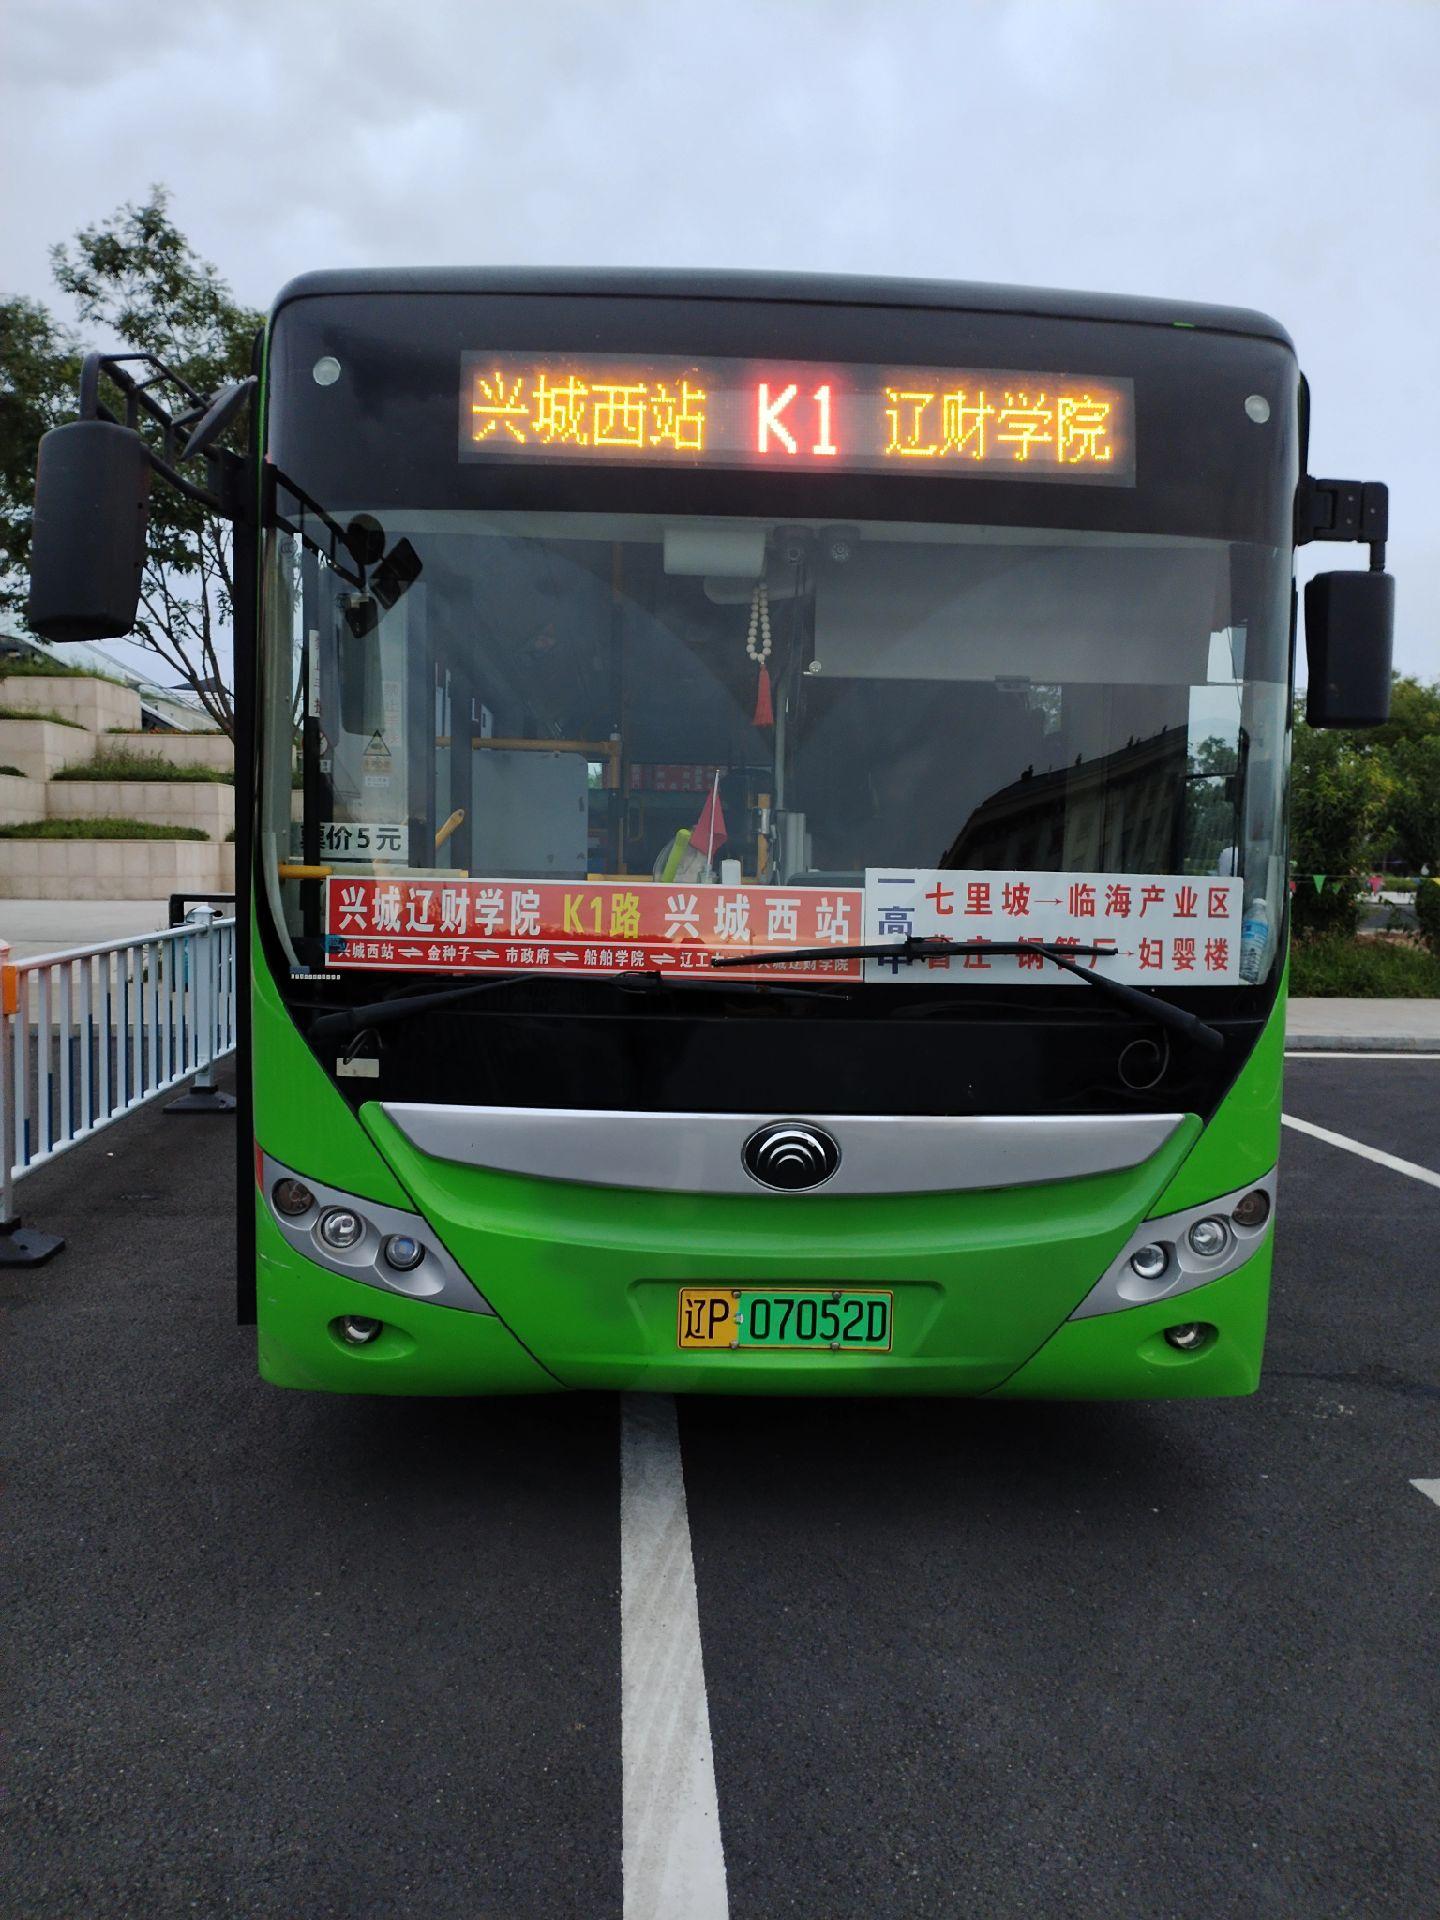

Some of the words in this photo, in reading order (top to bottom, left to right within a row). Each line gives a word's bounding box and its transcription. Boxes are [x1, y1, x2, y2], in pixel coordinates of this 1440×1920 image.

[473, 371, 708, 450] 兴城西站
[758, 384, 837, 455] K1
[885, 387, 1112, 462] 辽财学院
[338, 886, 541, 937] 兴城辽财学院
[563, 892, 641, 940] K1路
[665, 893, 852, 944] 兴城西站
[925, 882, 1031, 916] 七里坡
[1068, 883, 1230, 918] 临海产业区
[427, 944, 472, 962] 金种子
[505, 947, 551, 966] 市政府
[583, 947, 645, 968] 船舶学院
[1139, 937, 1229, 971] 妇婴楼
